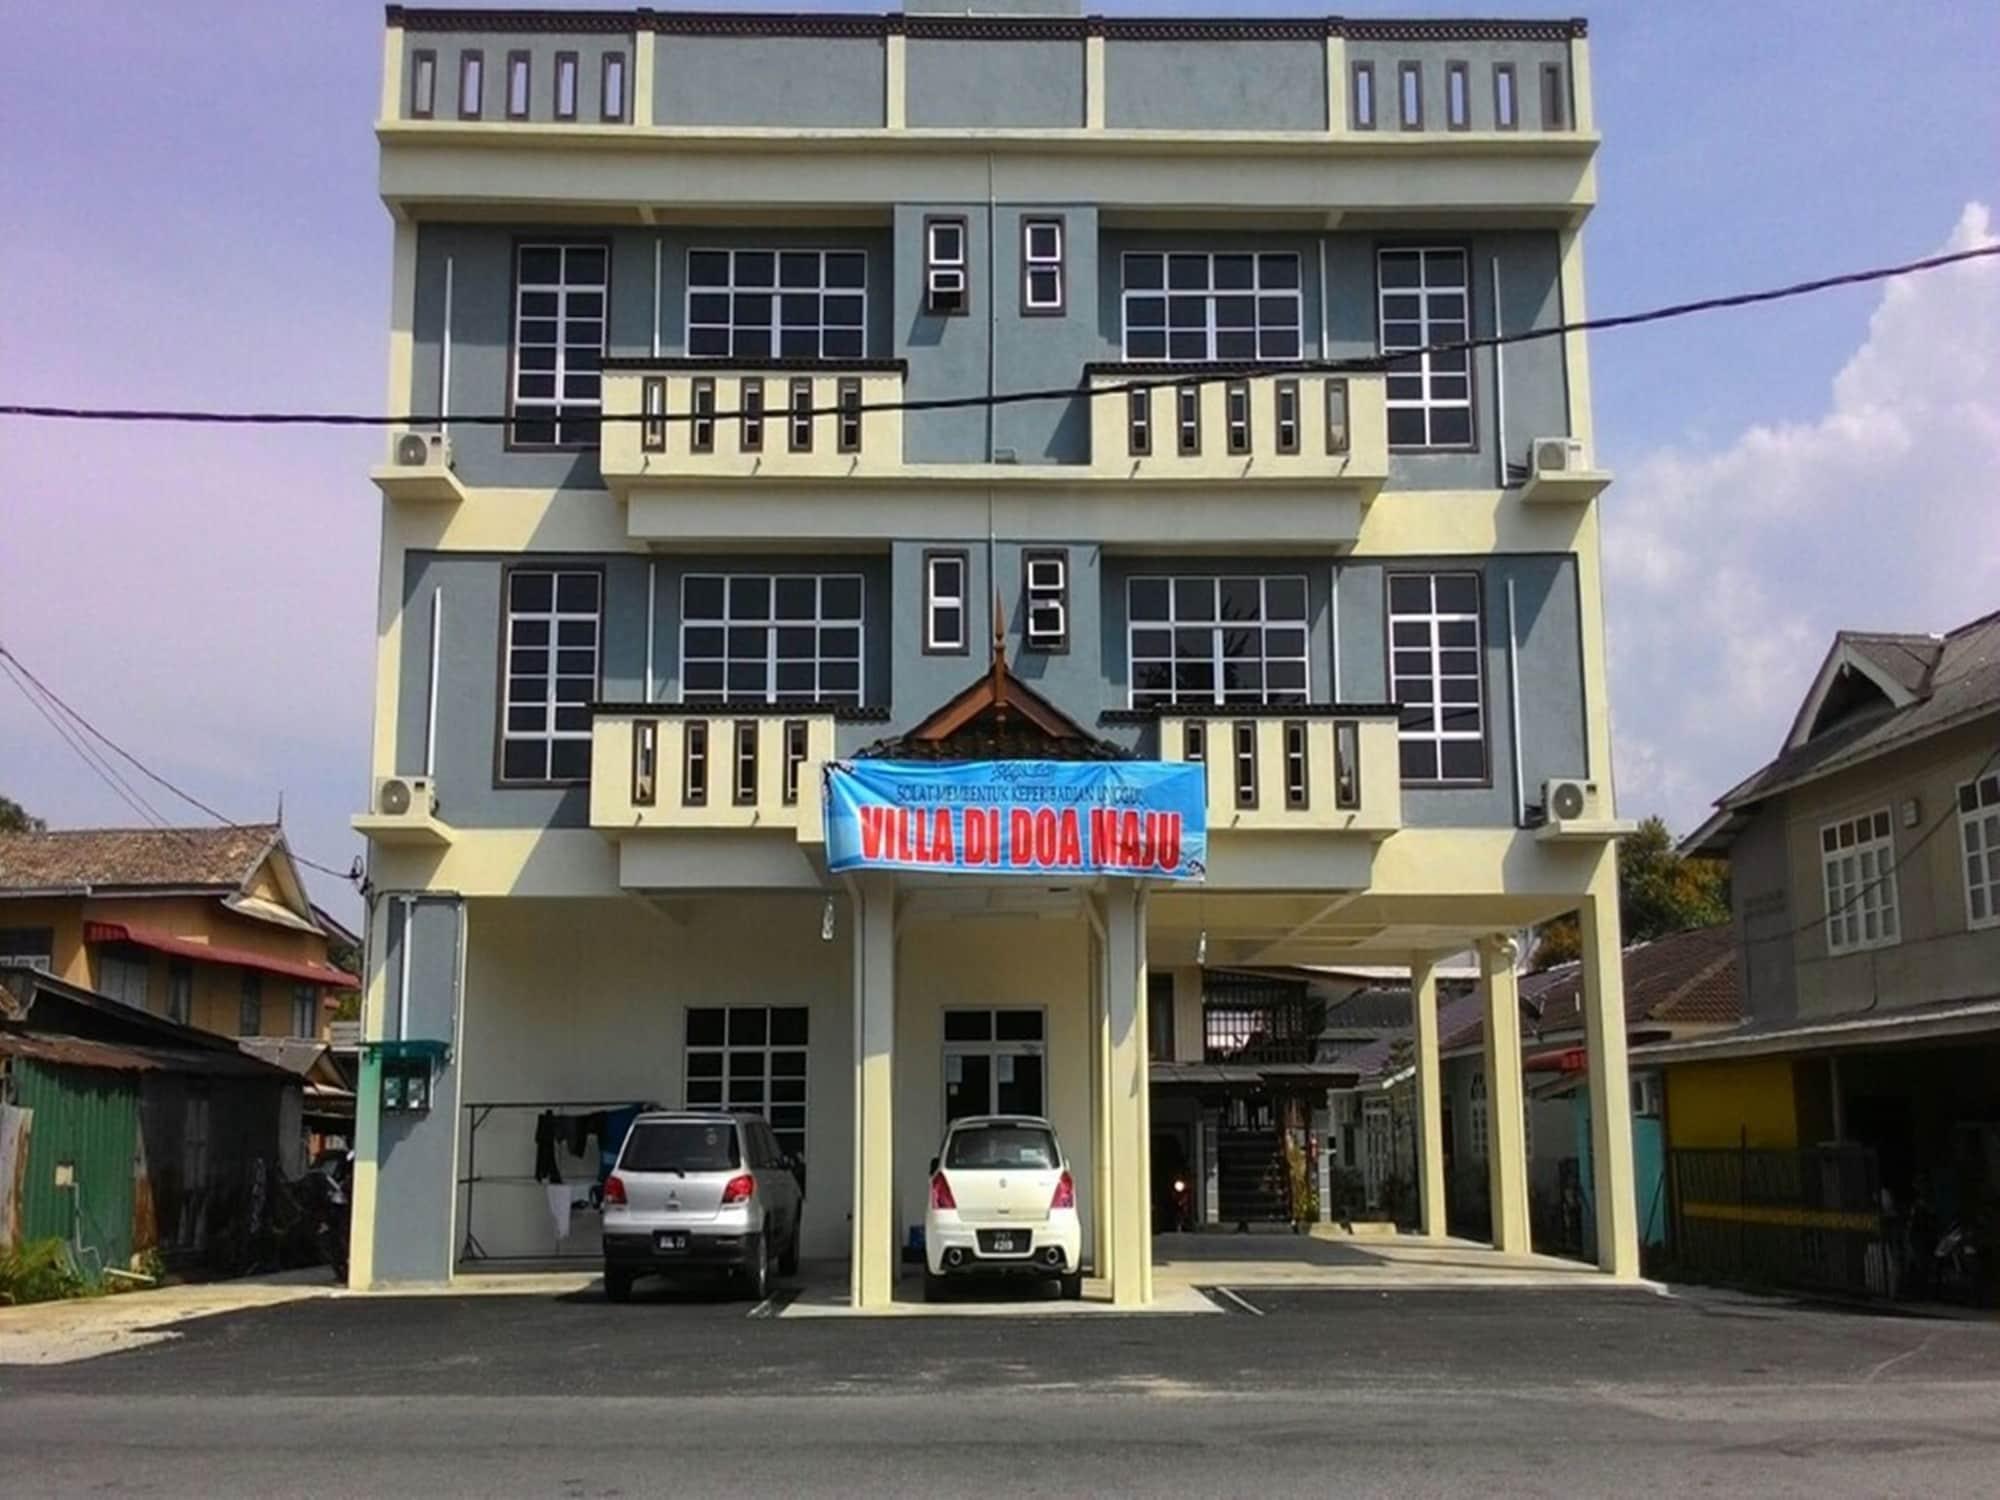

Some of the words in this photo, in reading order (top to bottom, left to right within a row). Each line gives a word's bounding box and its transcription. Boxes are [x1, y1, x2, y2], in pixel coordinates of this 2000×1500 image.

[860, 805, 954, 863] VILLA
[964, 808, 1000, 864] DI
[1011, 808, 1082, 866] DOA
